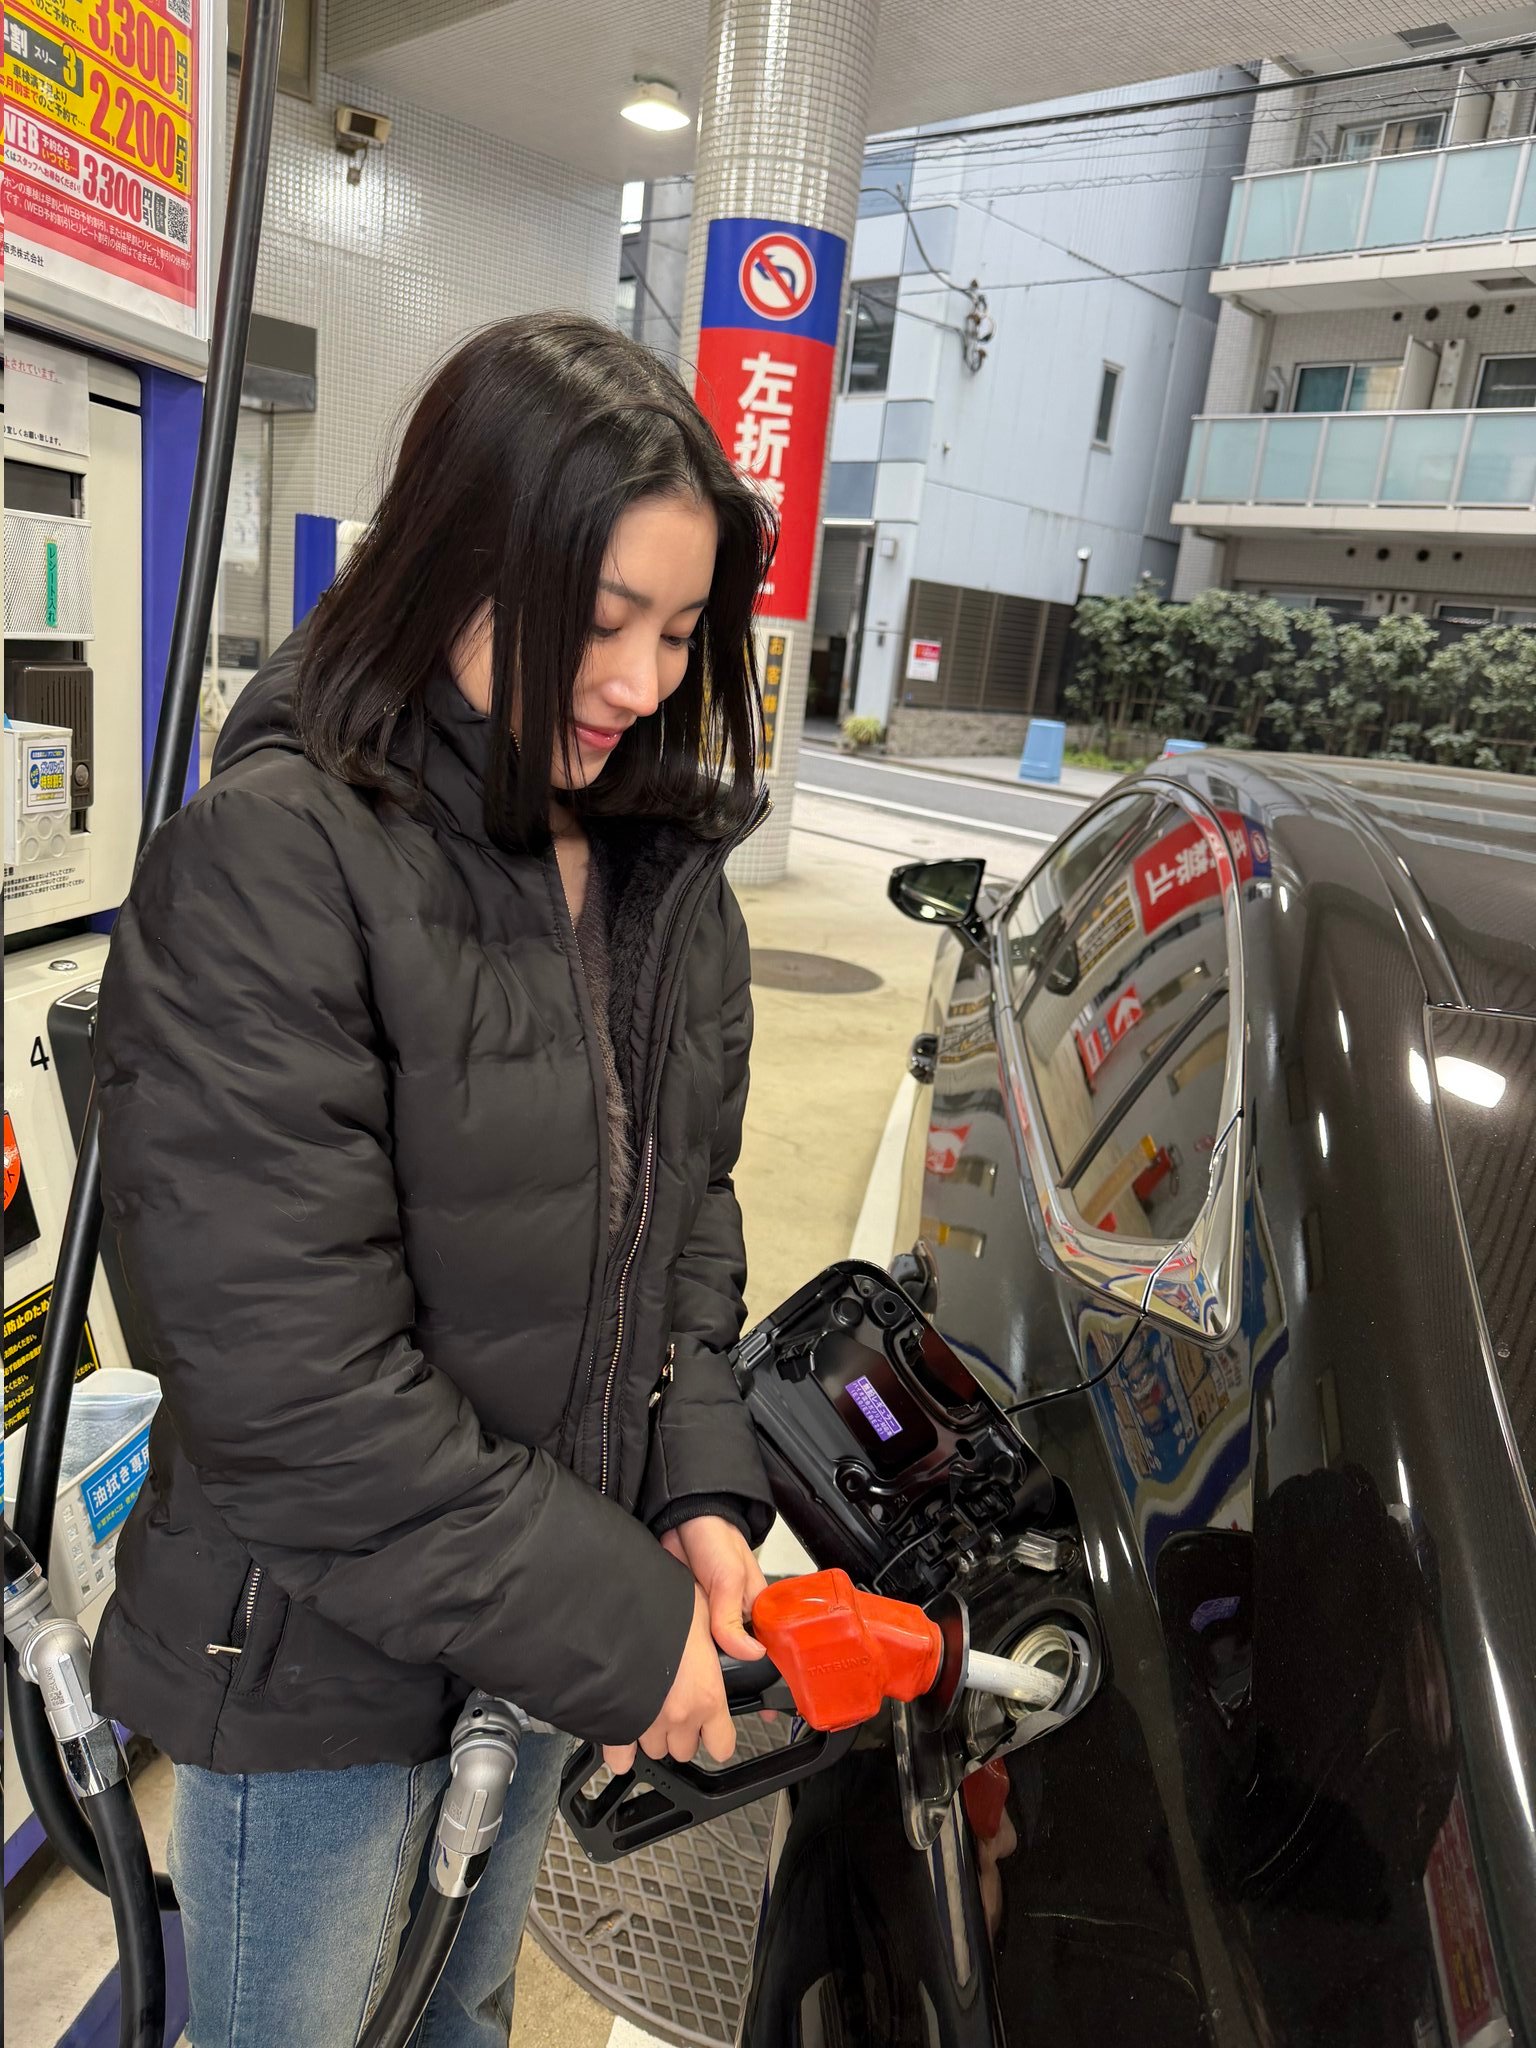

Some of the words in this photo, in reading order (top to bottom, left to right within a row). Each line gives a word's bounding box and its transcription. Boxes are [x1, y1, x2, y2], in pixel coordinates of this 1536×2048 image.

[62, 42, 77, 89] 3
[89, 69, 176, 179] 2,200
[82, 153, 142, 223] 3,300
[30, 1035, 50, 1071] 4
[4, 1298, 50, 1338] 防止のため
[807, 1655, 873, 1678] TATSUNO
